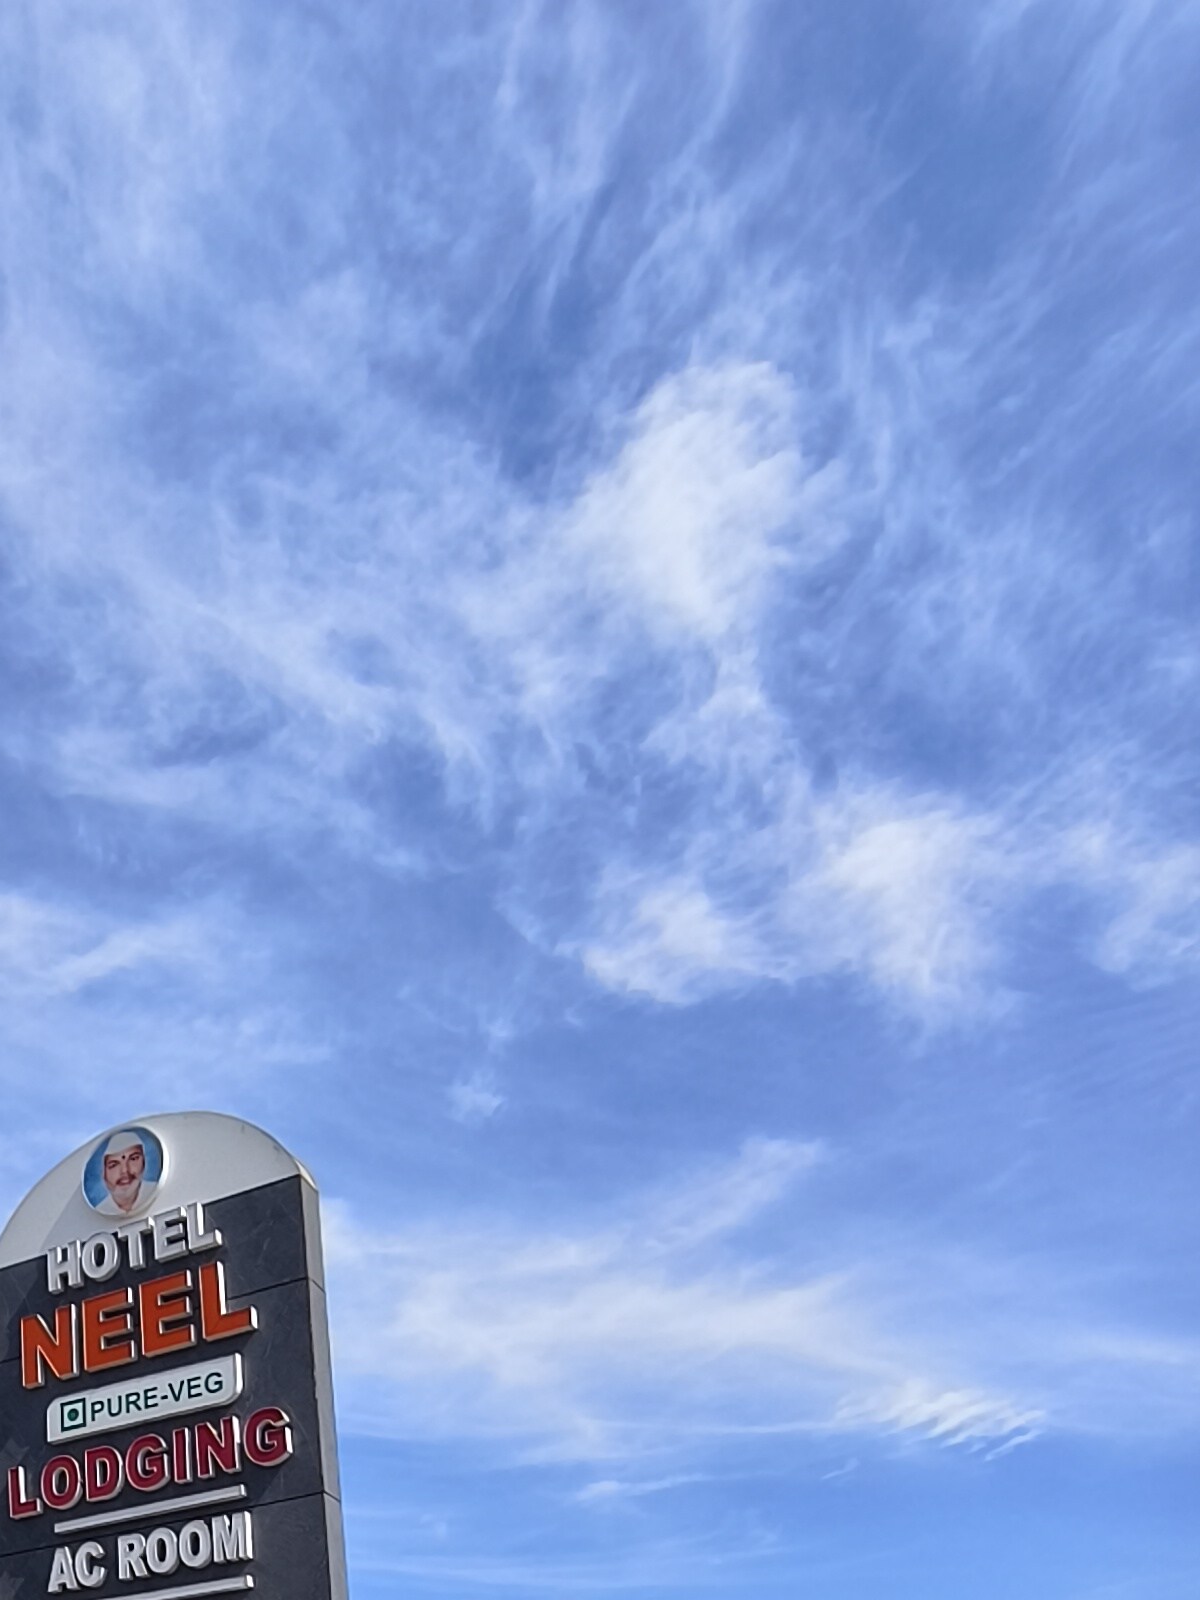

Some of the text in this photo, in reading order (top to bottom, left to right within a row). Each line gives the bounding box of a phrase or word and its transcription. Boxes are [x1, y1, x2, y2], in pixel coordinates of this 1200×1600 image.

[47, 1201, 222, 1294] HOTEL
[19, 1261, 258, 1390] NEEL
[90, 1371, 224, 1422] PURE-VEG
[7, 1406, 294, 1519] LODGING
[47, 1510, 254, 1594] AC ROOM
